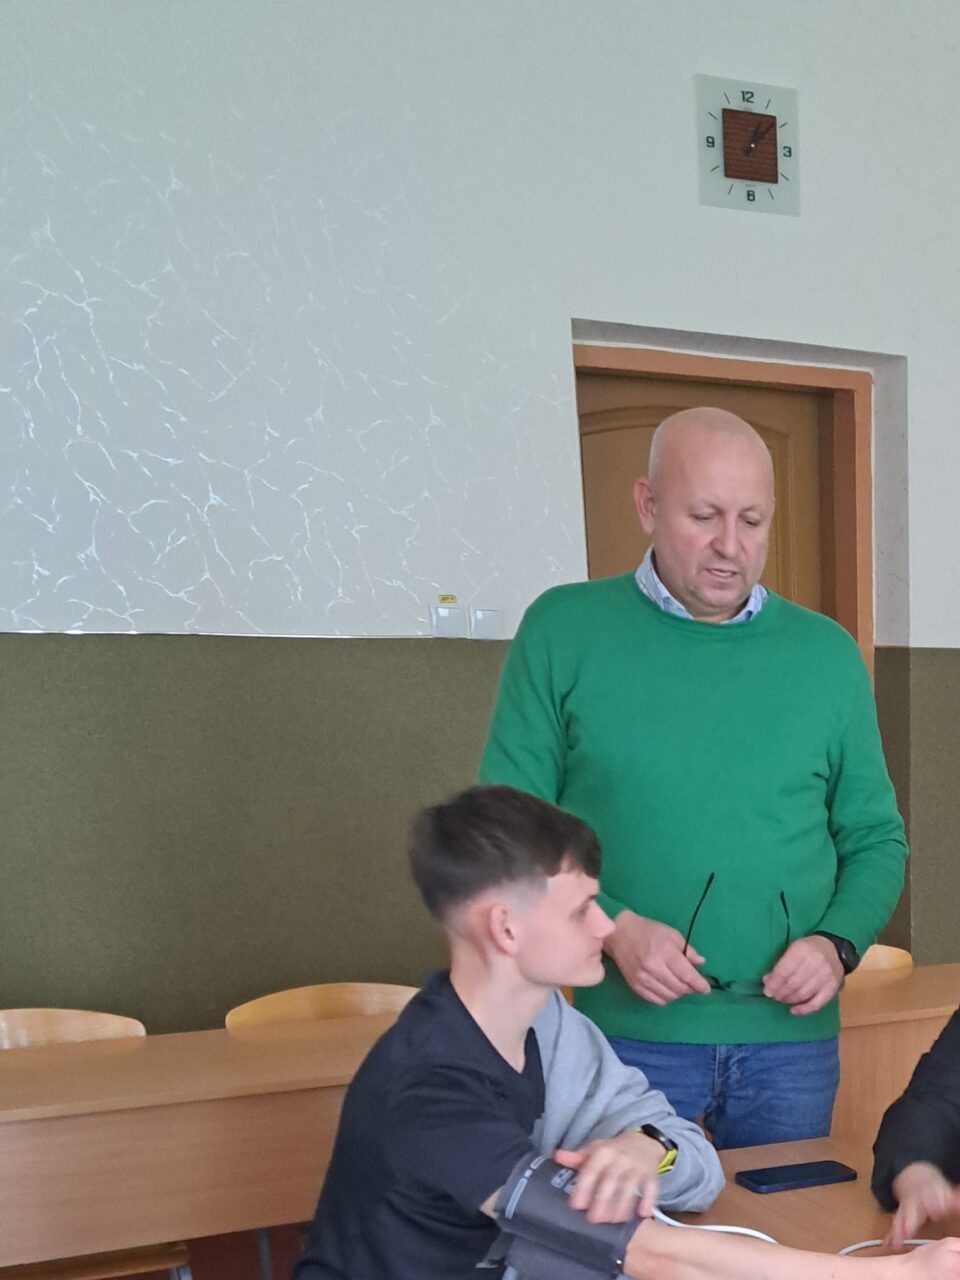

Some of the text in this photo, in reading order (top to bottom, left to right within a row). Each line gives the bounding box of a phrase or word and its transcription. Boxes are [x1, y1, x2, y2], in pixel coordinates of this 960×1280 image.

[740, 91, 754, 103] 12
[706, 136, 715, 148] 9
[783, 146, 792, 158] 3
[746, 190, 756, 202] 6
